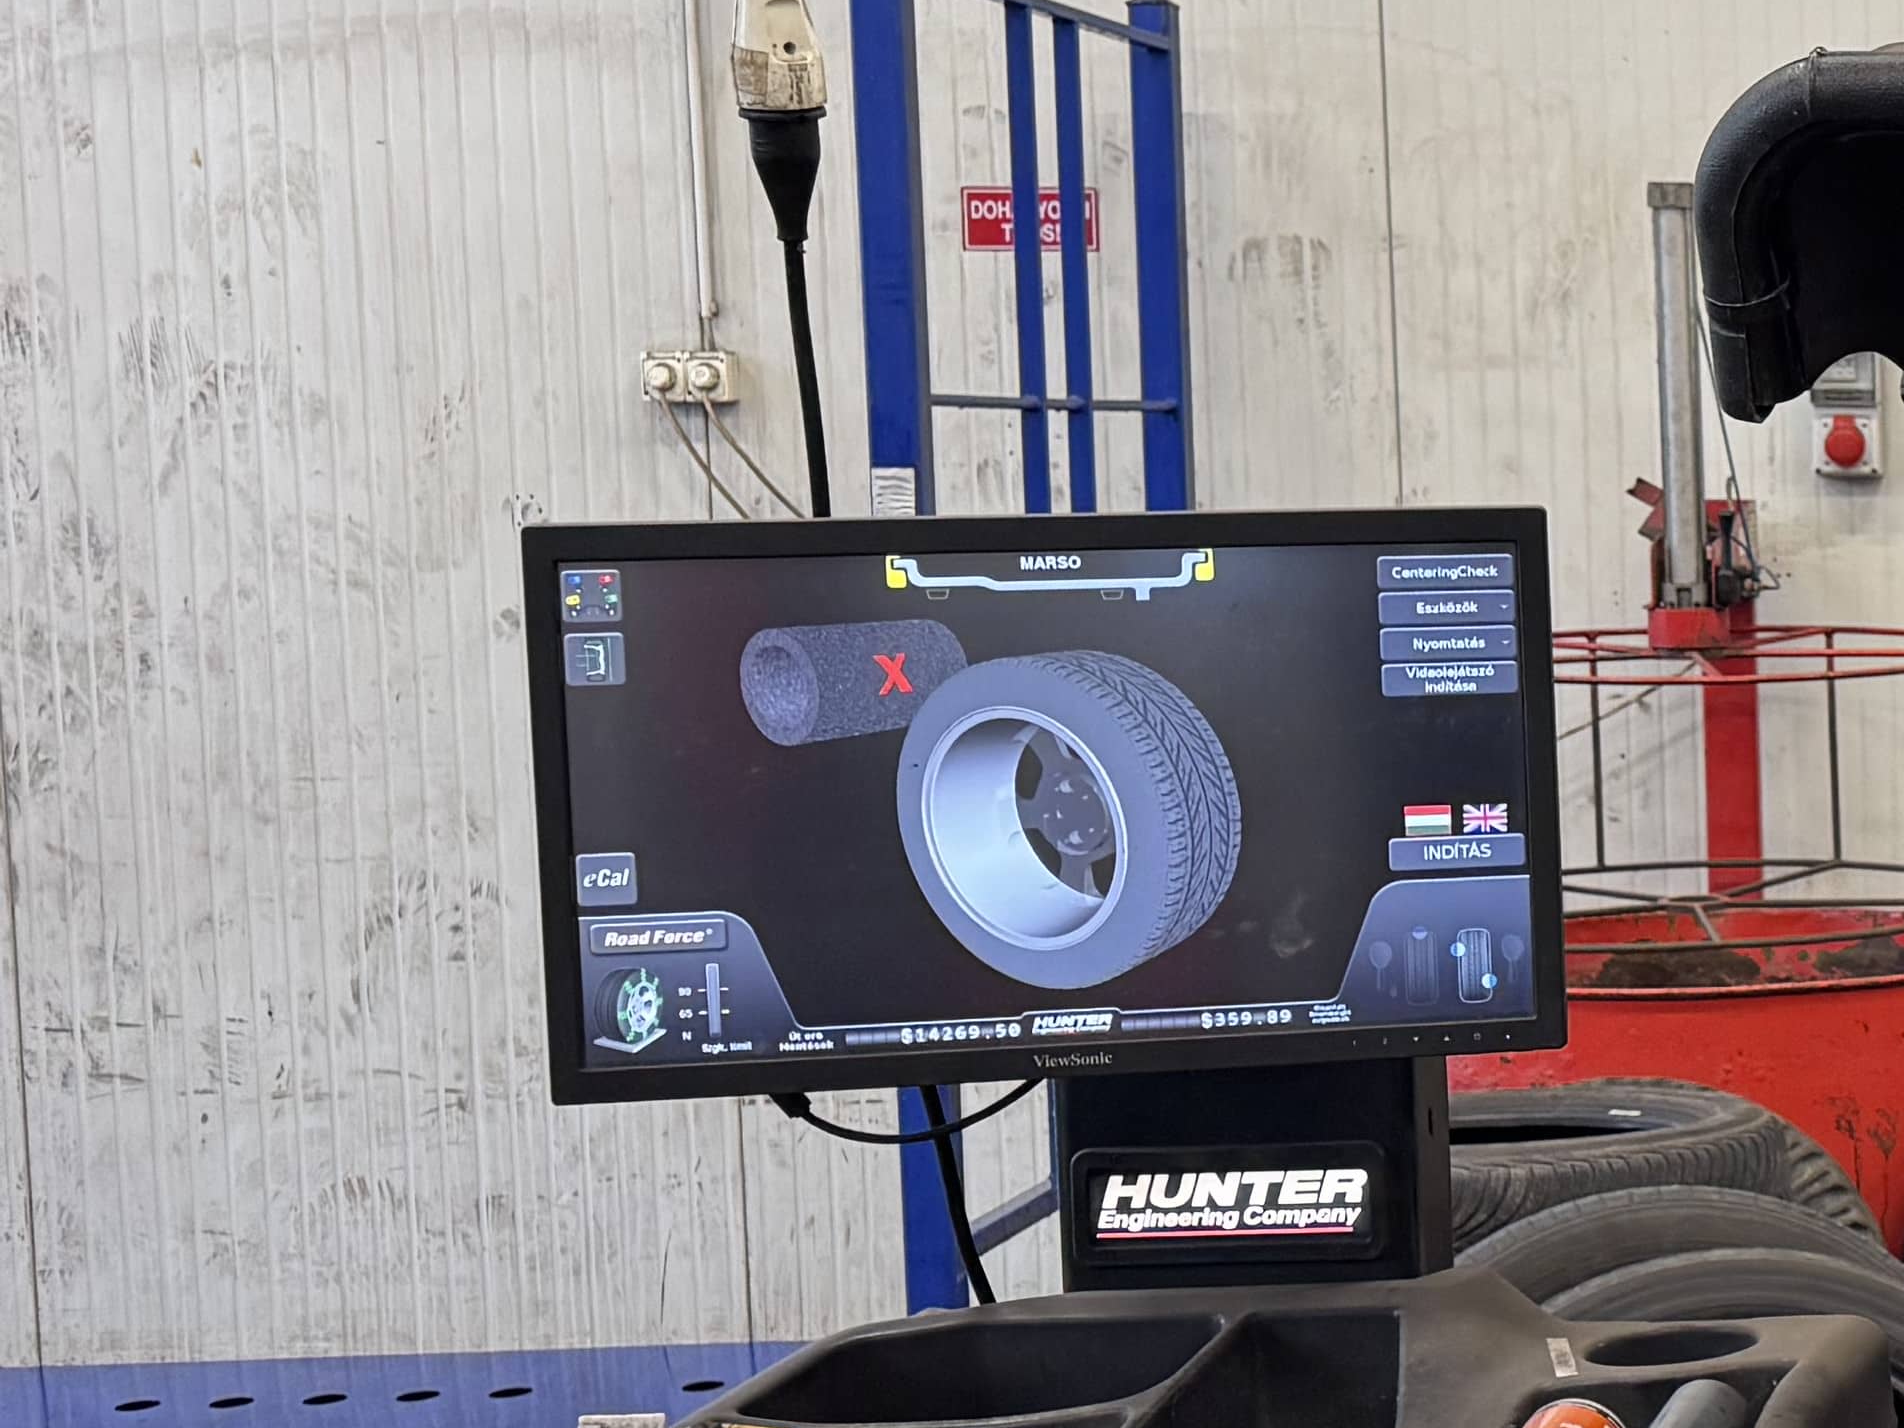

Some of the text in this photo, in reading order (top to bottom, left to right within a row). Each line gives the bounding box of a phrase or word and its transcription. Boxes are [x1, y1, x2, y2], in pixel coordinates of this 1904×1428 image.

[1020, 554, 1081, 571] MARSO
[1391, 565, 1498, 580] CenteringCheck
[1413, 636, 1486, 652] Nyomtatás
[1423, 842, 1492, 861] INDÍTÁS
[583, 868, 630, 888] eCal
[604, 930, 649, 947] Road
[679, 1009, 693, 1019] 65
[1033, 1014, 1113, 1029] HUNTER
[1201, 1009, 1293, 1029] $359.89
[682, 1031, 692, 1041] N
[901, 1022, 1021, 1045] $14269.50
[1033, 1052, 1112, 1068] ViewSonic
[1102, 1168, 1368, 1210] HUNTER
[1097, 1205, 1361, 1233] Engineering Company
